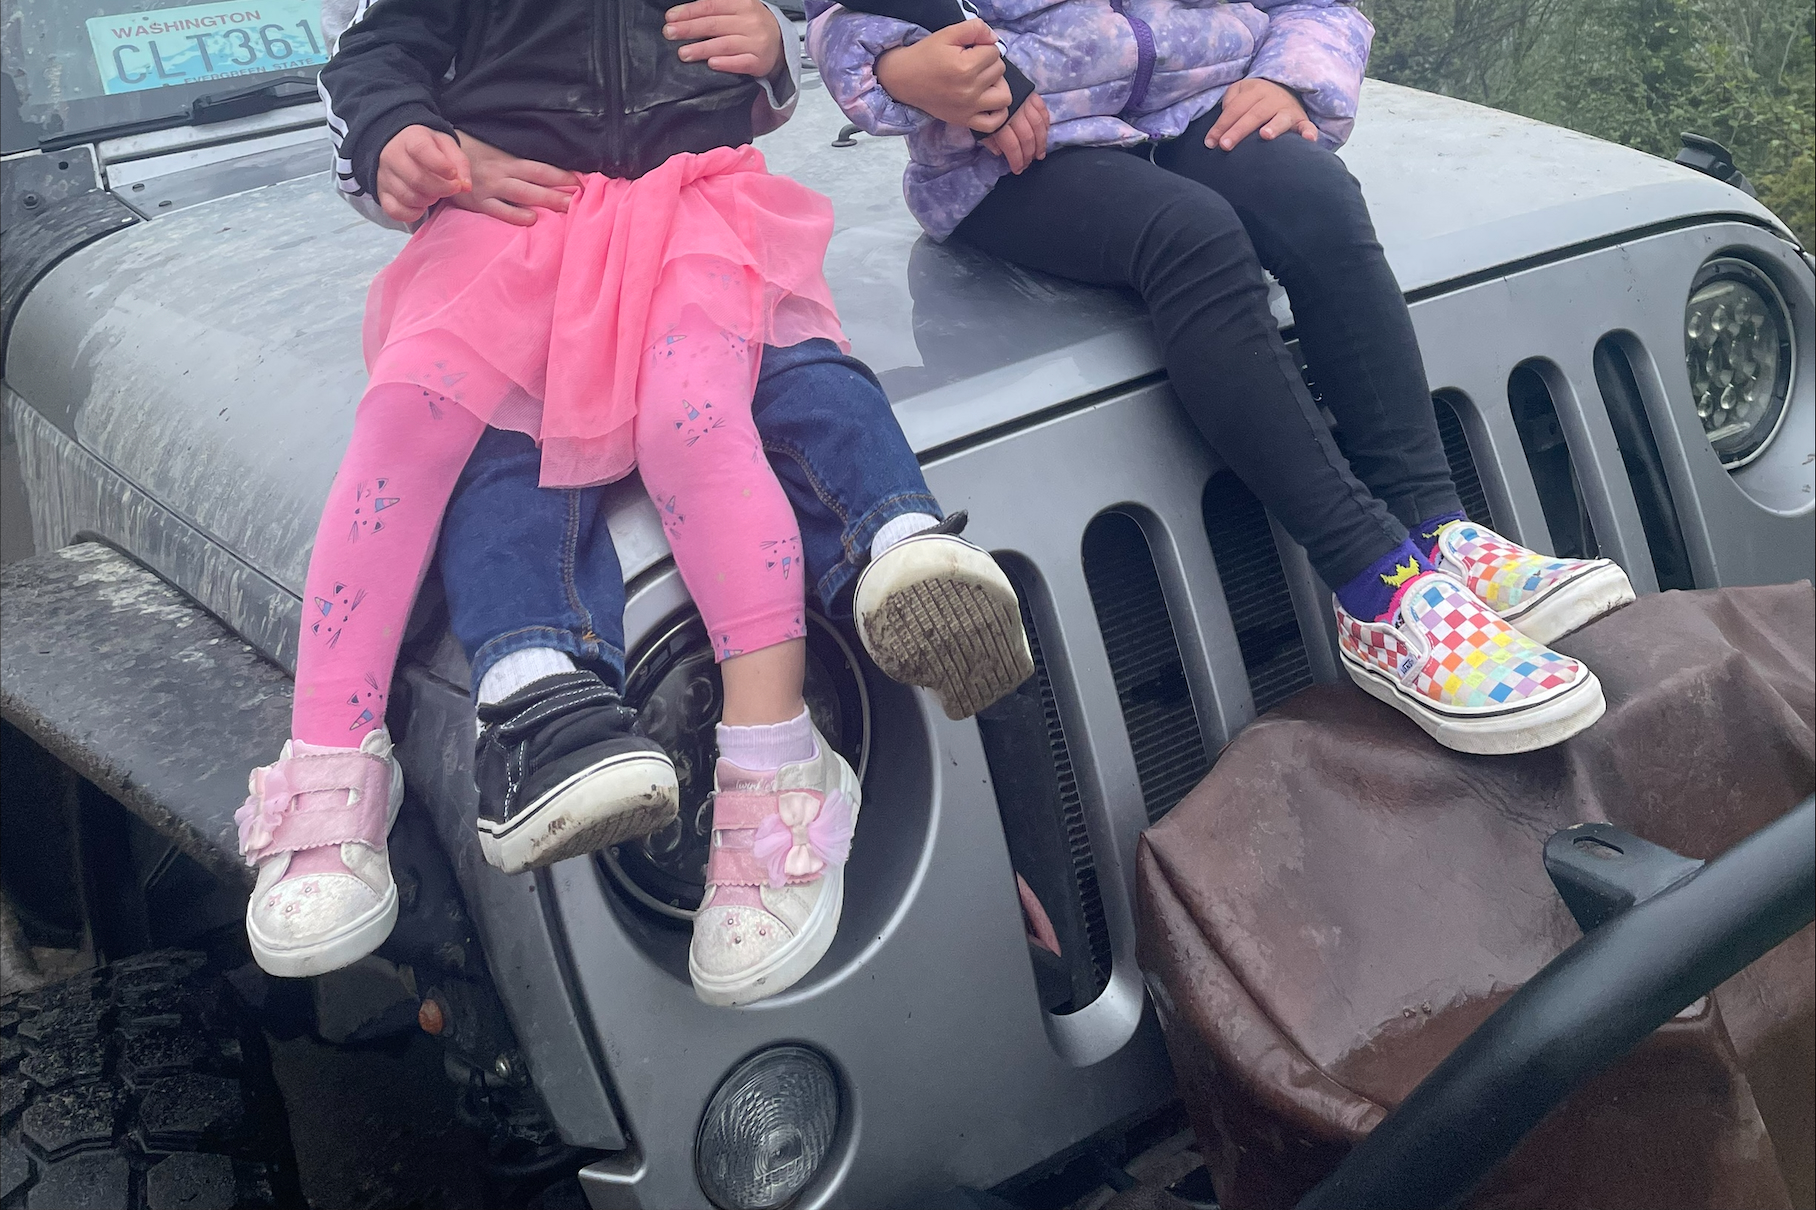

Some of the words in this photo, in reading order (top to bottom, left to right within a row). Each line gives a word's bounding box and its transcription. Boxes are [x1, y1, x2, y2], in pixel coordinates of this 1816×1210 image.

[111, 10, 261, 39] WASHINGTON
[183, 66, 266, 84] EVERGREEN
[272, 57, 315, 71] STATE
